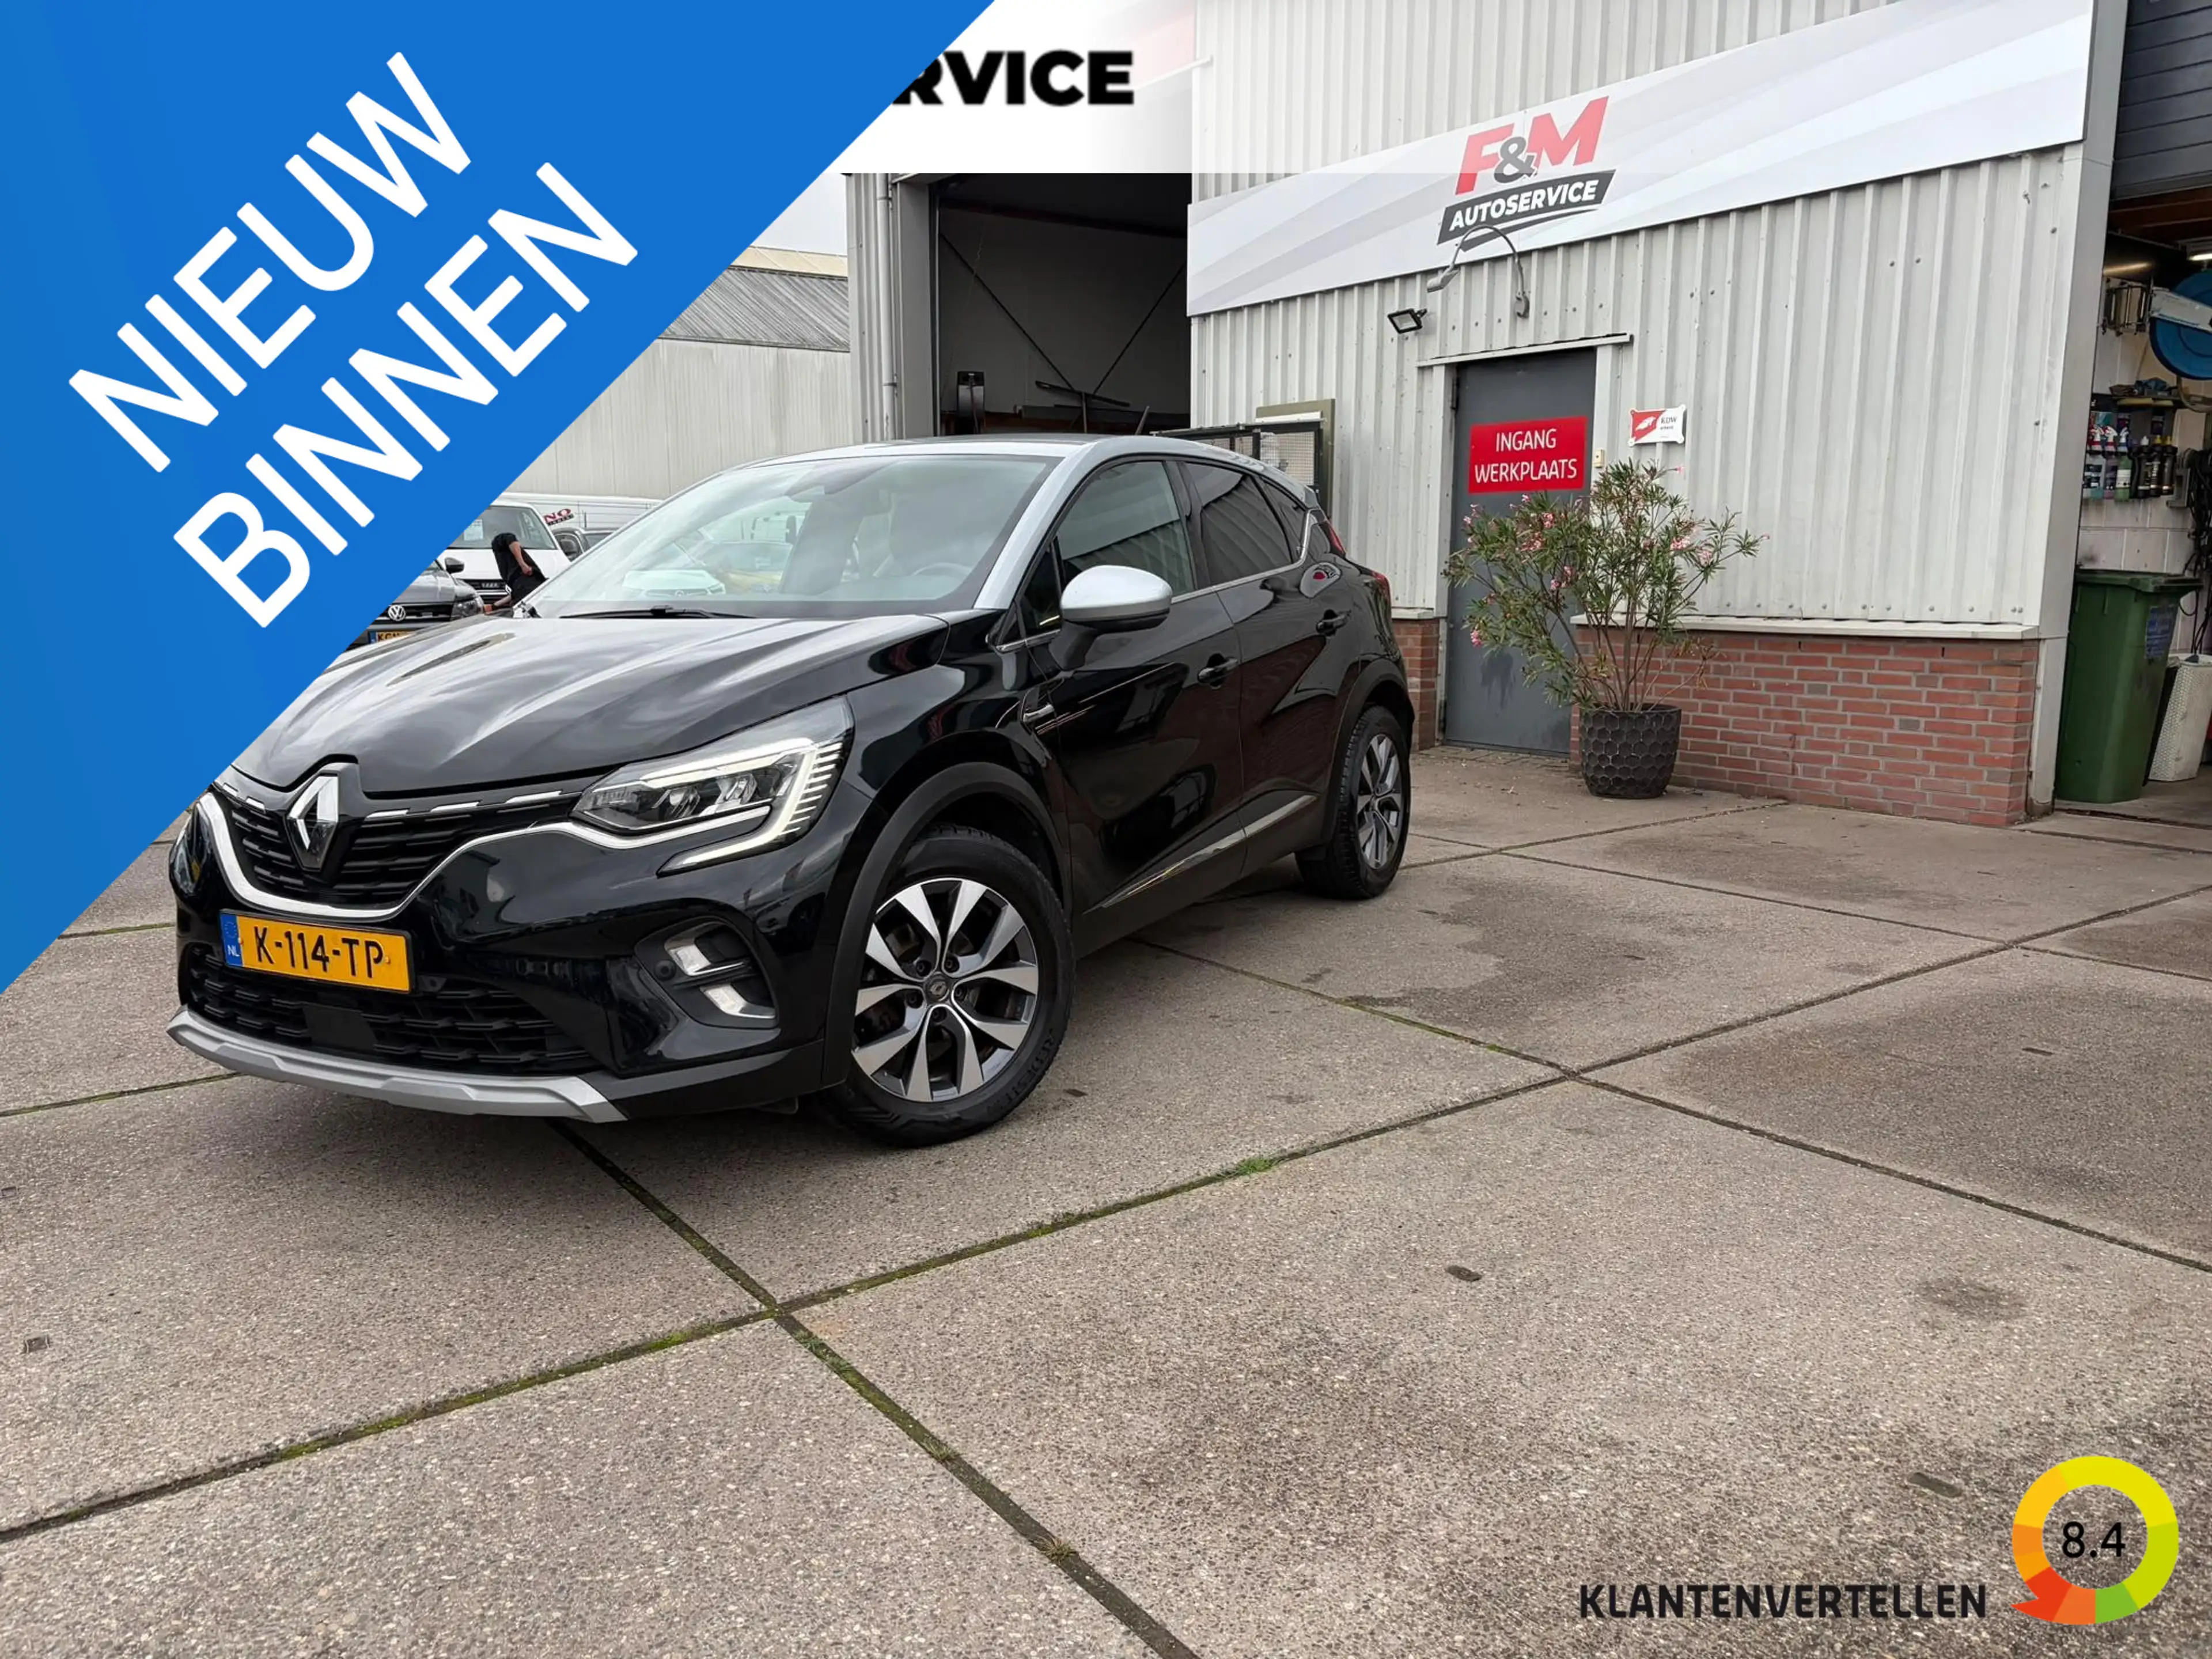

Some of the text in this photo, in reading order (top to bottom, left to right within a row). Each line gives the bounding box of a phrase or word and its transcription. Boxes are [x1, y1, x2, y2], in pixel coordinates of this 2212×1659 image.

[1455, 95, 1609, 195] F&M
[1449, 179, 1600, 232] AUTOSERVICE
[1495, 428, 1556, 452] INGANG
[1474, 458, 1577, 483] WERKPLAATS
[253, 925, 384, 979] K-114-TP
